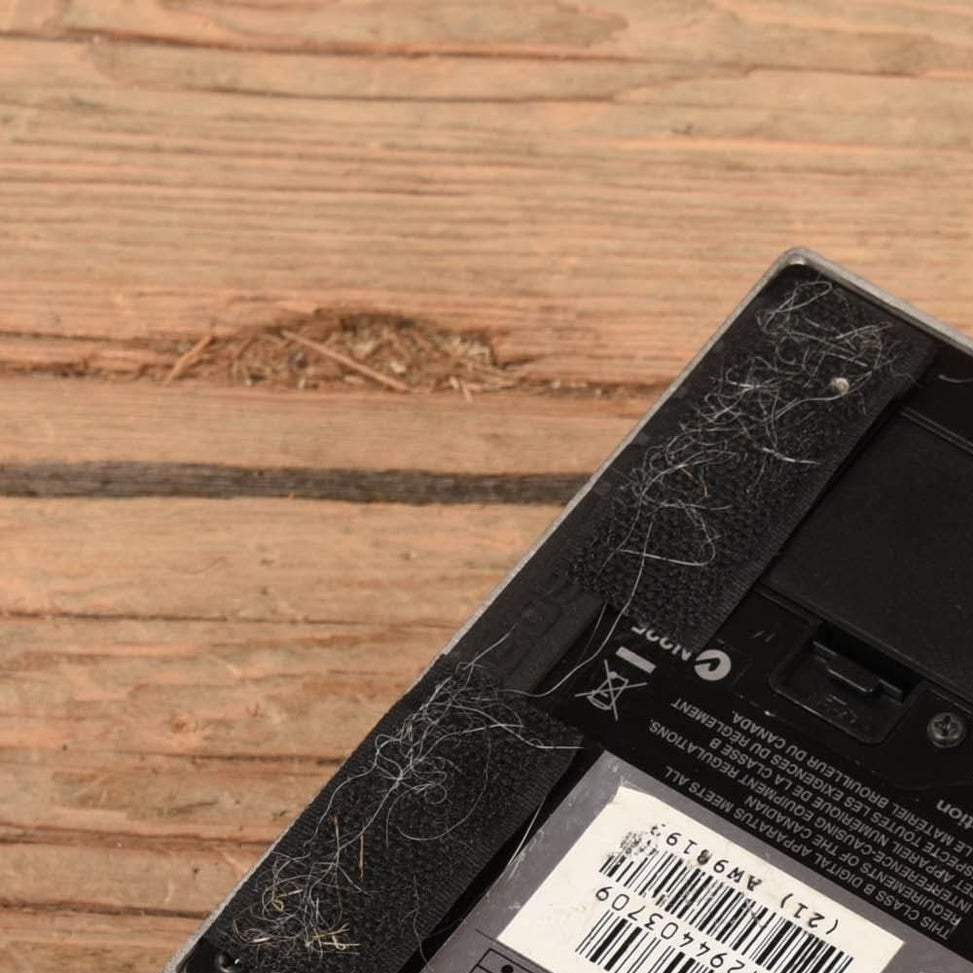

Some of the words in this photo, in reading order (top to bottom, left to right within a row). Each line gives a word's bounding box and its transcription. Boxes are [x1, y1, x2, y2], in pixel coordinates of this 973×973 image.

[669, 696, 752, 748] RÈGLEMENT
[730, 709, 787, 750] CANADA.
[647, 717, 741, 780] REGULATIONS.
[707, 736, 723, 750] B
[719, 742, 774, 779] CLASSE
[747, 741, 772, 760] DU
[783, 743, 808, 762] DU
[663, 764, 691, 787] ALL
[768, 752, 845, 802] EXIGENCES
[772, 772, 794, 791] LA
[790, 783, 814, 803] DE
[805, 754, 890, 809] BROUILLEUR
[686, 780, 735, 814] MEETS
[736, 773, 815, 822] EQUIPMENT
[842, 794, 872, 817] LES
[731, 806, 813, 858] APPARATUS
[742, 793, 813, 840] CANADIAN
[809, 794, 891, 848] NUMÉRIQUE
[868, 810, 922, 848] TOUTES
[890, 801, 955, 847] MATÉRIEL
[810, 832, 839, 857] THE
[836, 851, 861, 867] OF
[890, 839, 956, 884] APPAREIL
[951, 839, 973, 858] LE
[812, 815, 973, 914] INTERFERENCE-CAUSING
[812, 851, 864, 889] DIGITAL
[858, 861, 963, 928] REQUIREMENTS
[861, 881, 877, 896] B
[873, 888, 921, 921] CLASS
[778, 891, 839, 936] (21)
[918, 914, 951, 941] THIS
